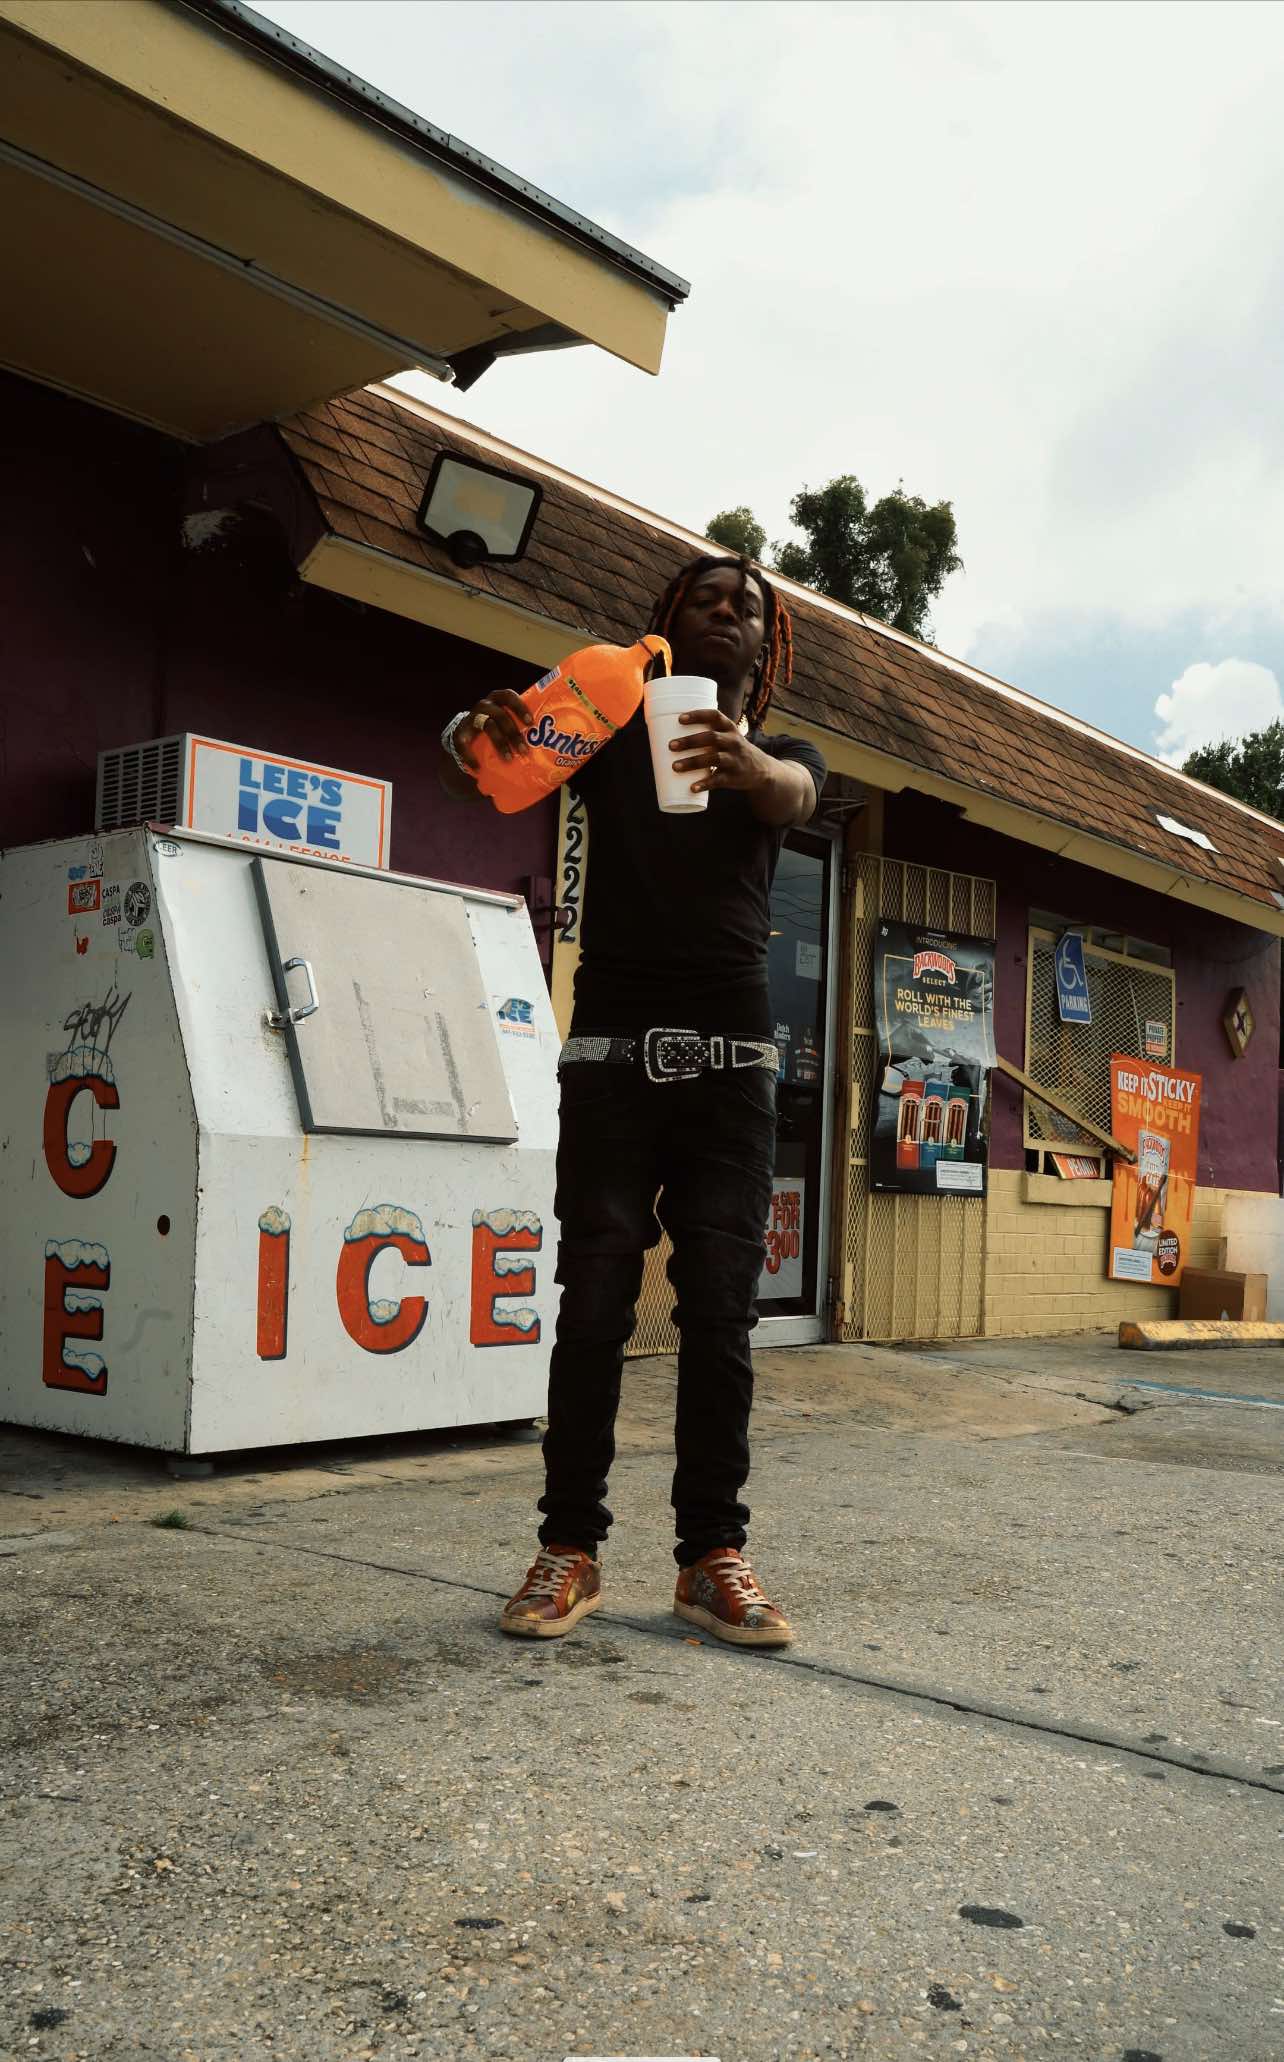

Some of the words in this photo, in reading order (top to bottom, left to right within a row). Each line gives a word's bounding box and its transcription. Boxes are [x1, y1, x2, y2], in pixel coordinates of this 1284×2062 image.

[239, 758, 342, 807] LEE'S
[237, 790, 341, 850] ICE
[913, 951, 956, 984] BACKWOODS
[922, 977, 946, 986] SELECT
[894, 1000, 940, 1016] WORLD'S
[942, 1008, 976, 1022] FINEST
[897, 989, 923, 1003] ROLL
[925, 992, 951, 1007] WITH
[953, 997, 973, 1011] THE
[1061, 994, 1089, 1012] PARKING
[918, 1016, 956, 1032] LEAVES
[1117, 1070, 1139, 1093] KEEP
[1148, 1071, 1196, 1104] STICKY
[1117, 1091, 1192, 1135] SMOOTH
[773, 1204, 800, 1230] FOR
[1158, 1246, 1178, 1256] EDITION
[1159, 1237, 1178, 1247] LIMITED
[257, 1204, 542, 1361] ICE
